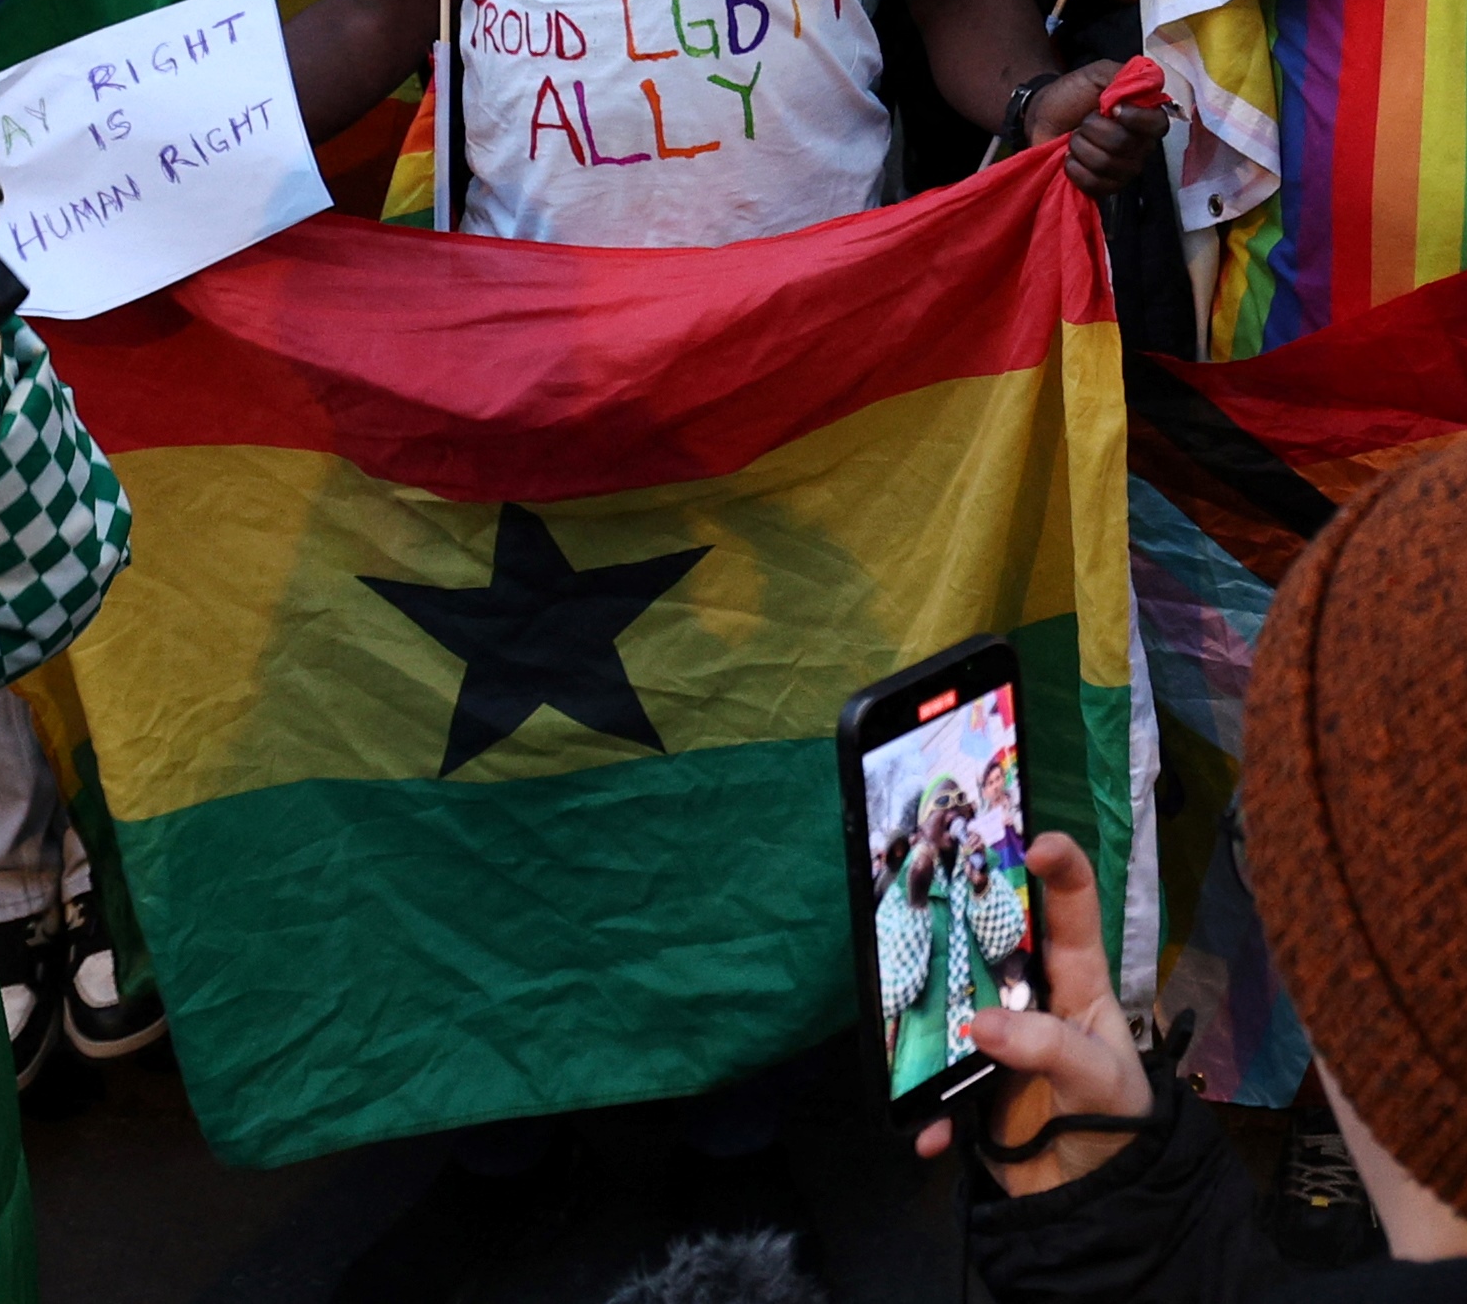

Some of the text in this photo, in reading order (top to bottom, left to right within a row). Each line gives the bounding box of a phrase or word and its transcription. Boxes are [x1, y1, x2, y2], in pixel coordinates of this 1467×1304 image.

[87, 10, 246, 102] RIGHT
[87, 108, 133, 151] IS
[530, 61, 761, 168] ALLY
[8, 98, 274, 262] HUMAN RIGHT
